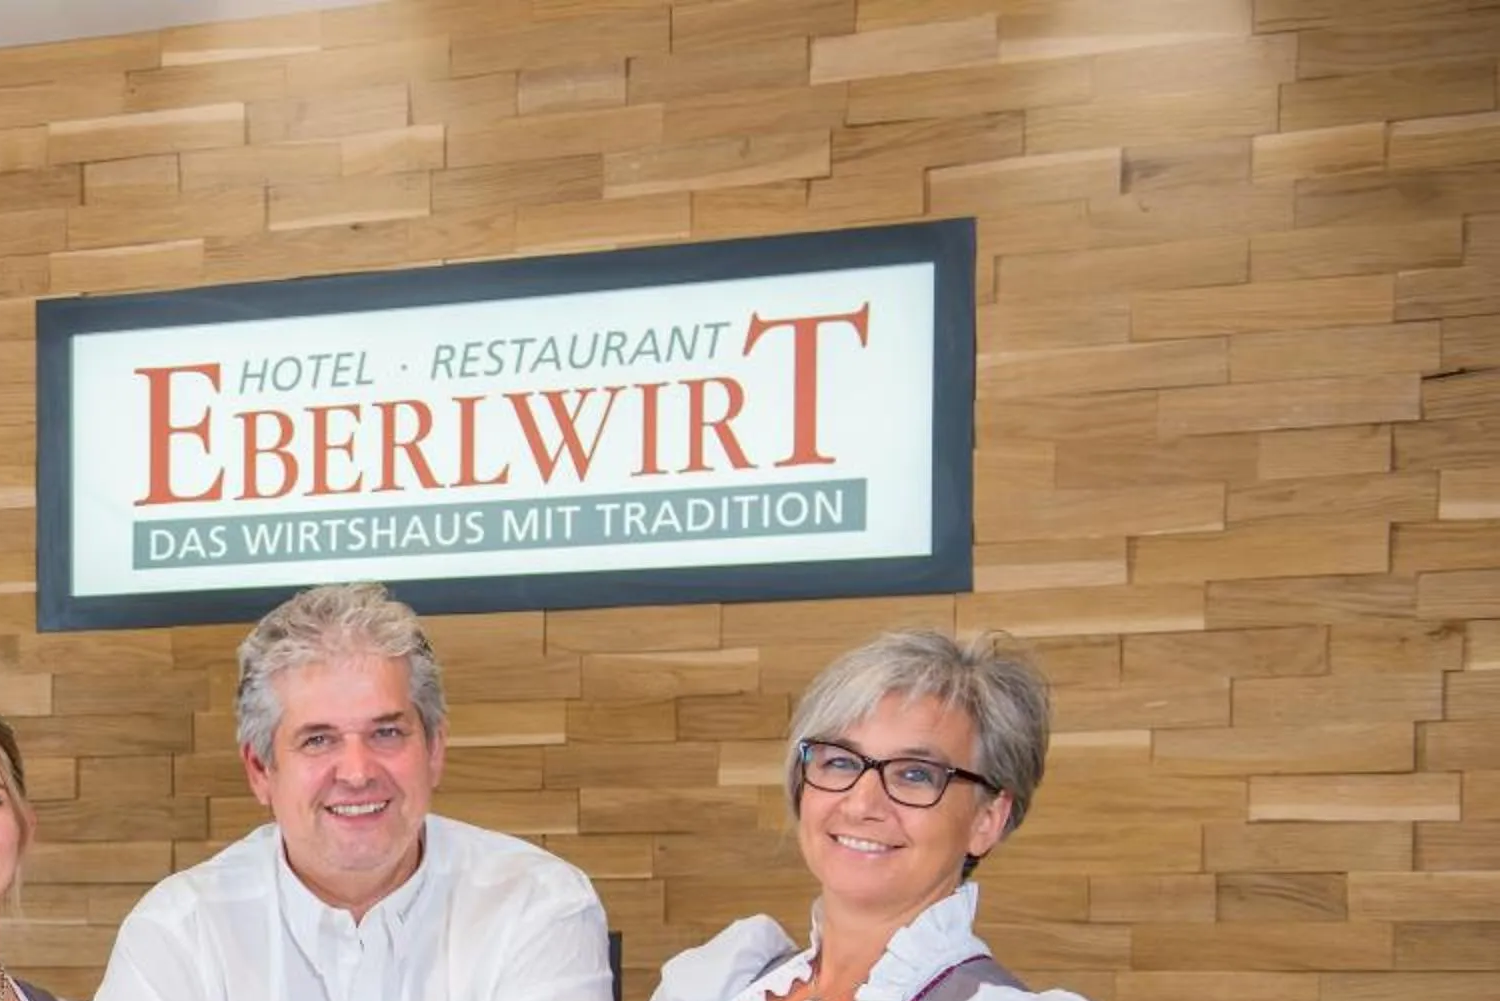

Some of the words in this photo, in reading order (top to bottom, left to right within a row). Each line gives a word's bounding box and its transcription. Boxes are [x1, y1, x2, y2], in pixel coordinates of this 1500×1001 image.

[239, 351, 374, 395] HOTEL
[430, 321, 732, 381] RESTAURANT
[133, 301, 869, 507] EBERLWIRT
[149, 525, 228, 561] DAS
[241, 511, 485, 556] WIRTSHAUS
[503, 506, 581, 543] MIT
[595, 490, 843, 537] TRADITION
